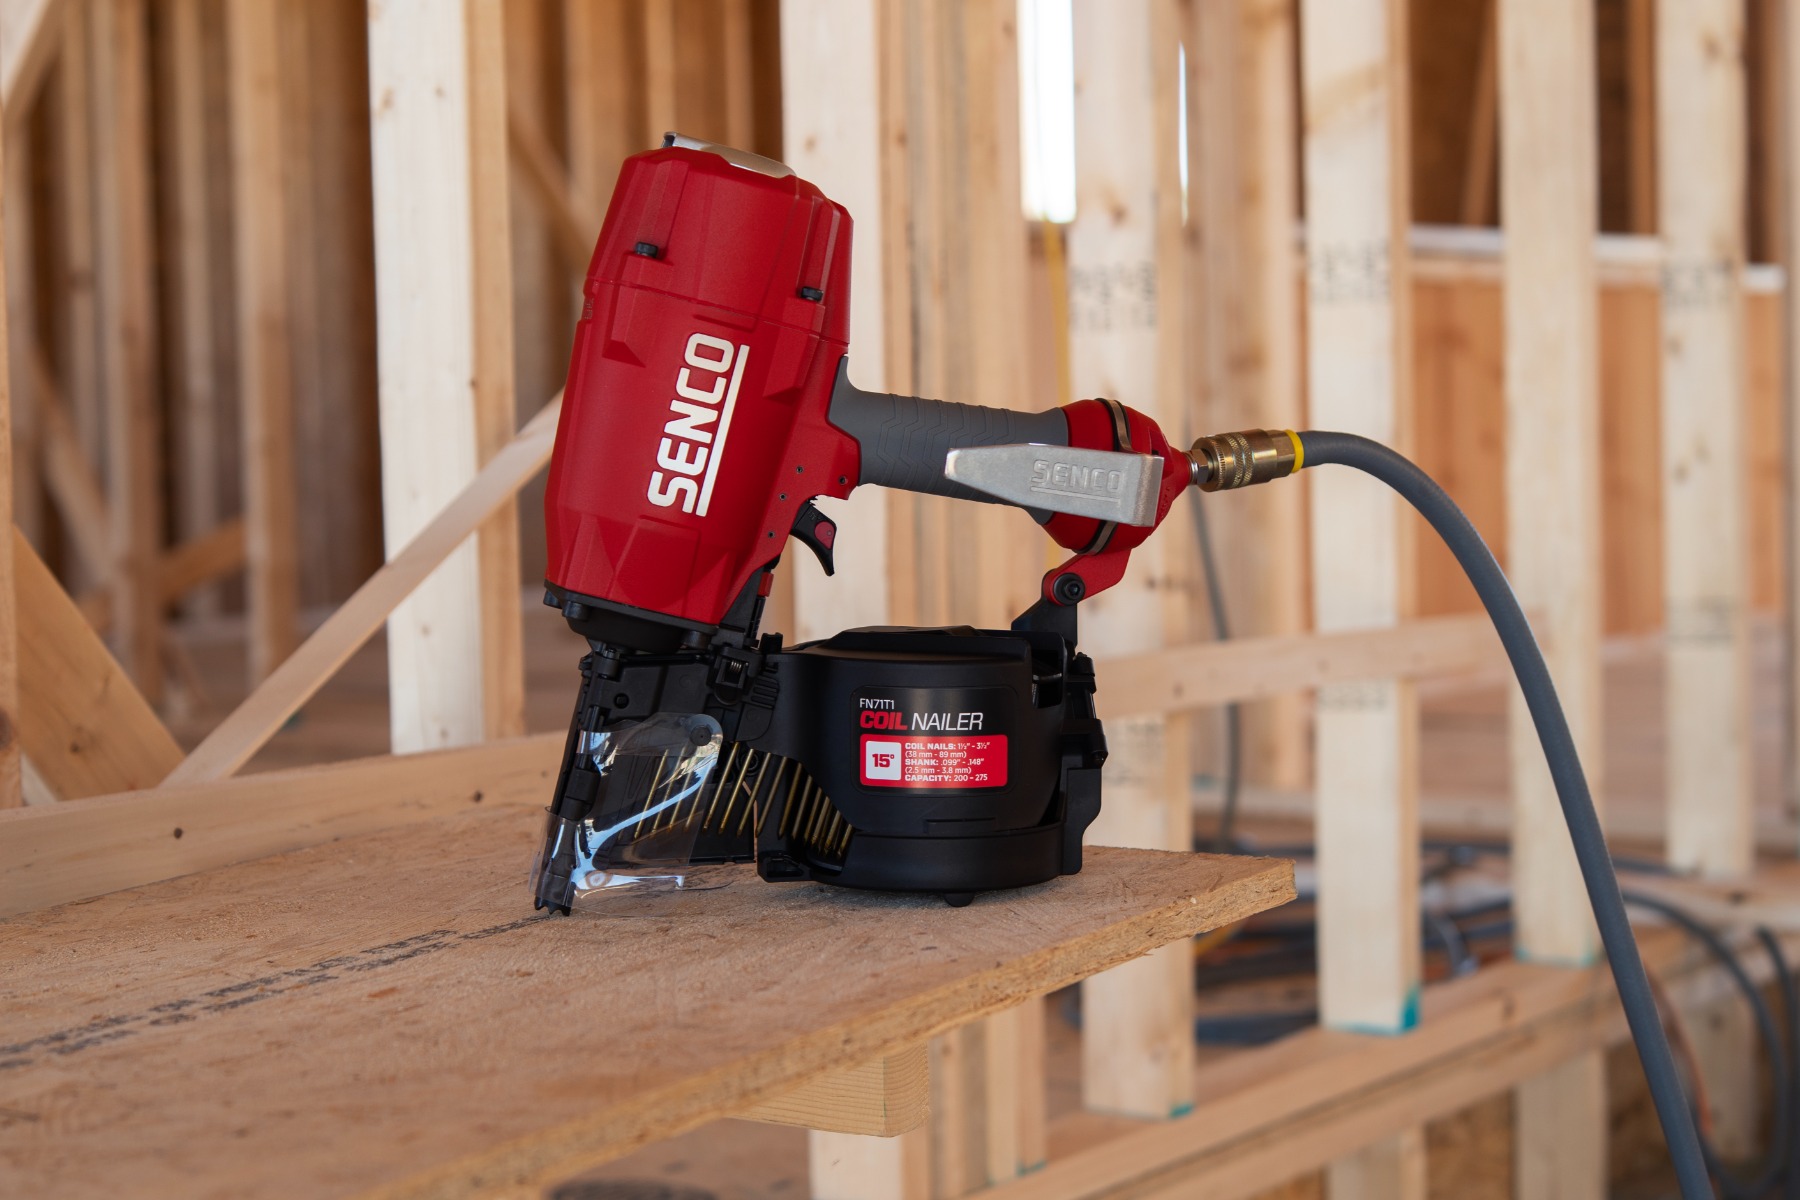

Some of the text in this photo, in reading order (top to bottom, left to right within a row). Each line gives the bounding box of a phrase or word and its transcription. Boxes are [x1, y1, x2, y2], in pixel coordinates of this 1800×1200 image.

[647, 333, 734, 513] SENCO
[1030, 459, 1122, 492] SENCO
[859, 698, 895, 710] FN71T1
[860, 710, 984, 731] COIL NAILER
[905, 742, 926, 750] COIL
[927, 742, 956, 750] NAILS:
[872, 753, 895, 768] 15°
[905, 774, 952, 782] CAPACITY:
[953, 774, 968, 782] 200
